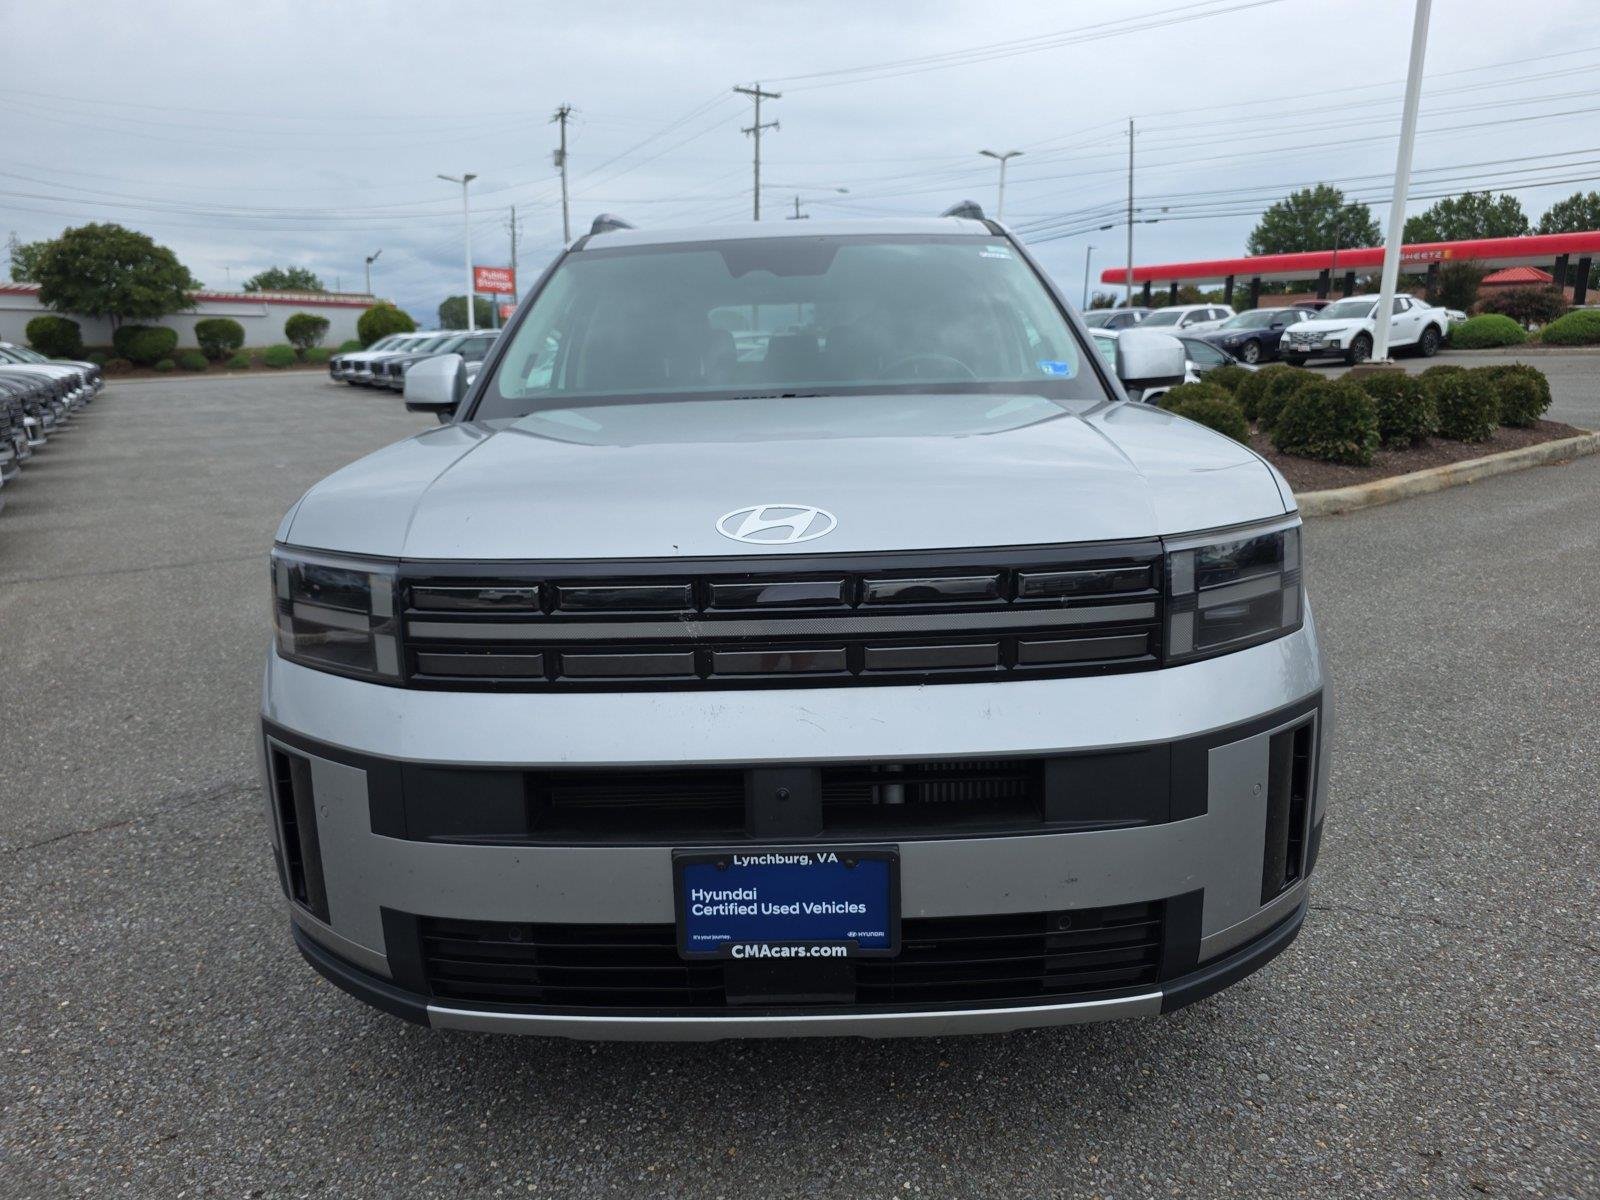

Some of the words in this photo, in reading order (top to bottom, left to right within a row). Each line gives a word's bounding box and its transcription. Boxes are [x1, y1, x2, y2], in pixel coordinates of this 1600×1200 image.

[733, 853, 813, 867] Lynchburg,
[817, 853, 838, 863] VA
[691, 887, 757, 903] Hyundai
[691, 902, 758, 916] Certified
[761, 902, 800, 915] Used
[803, 901, 866, 914] Vehicles
[731, 944, 848, 959] CMAcars.com
